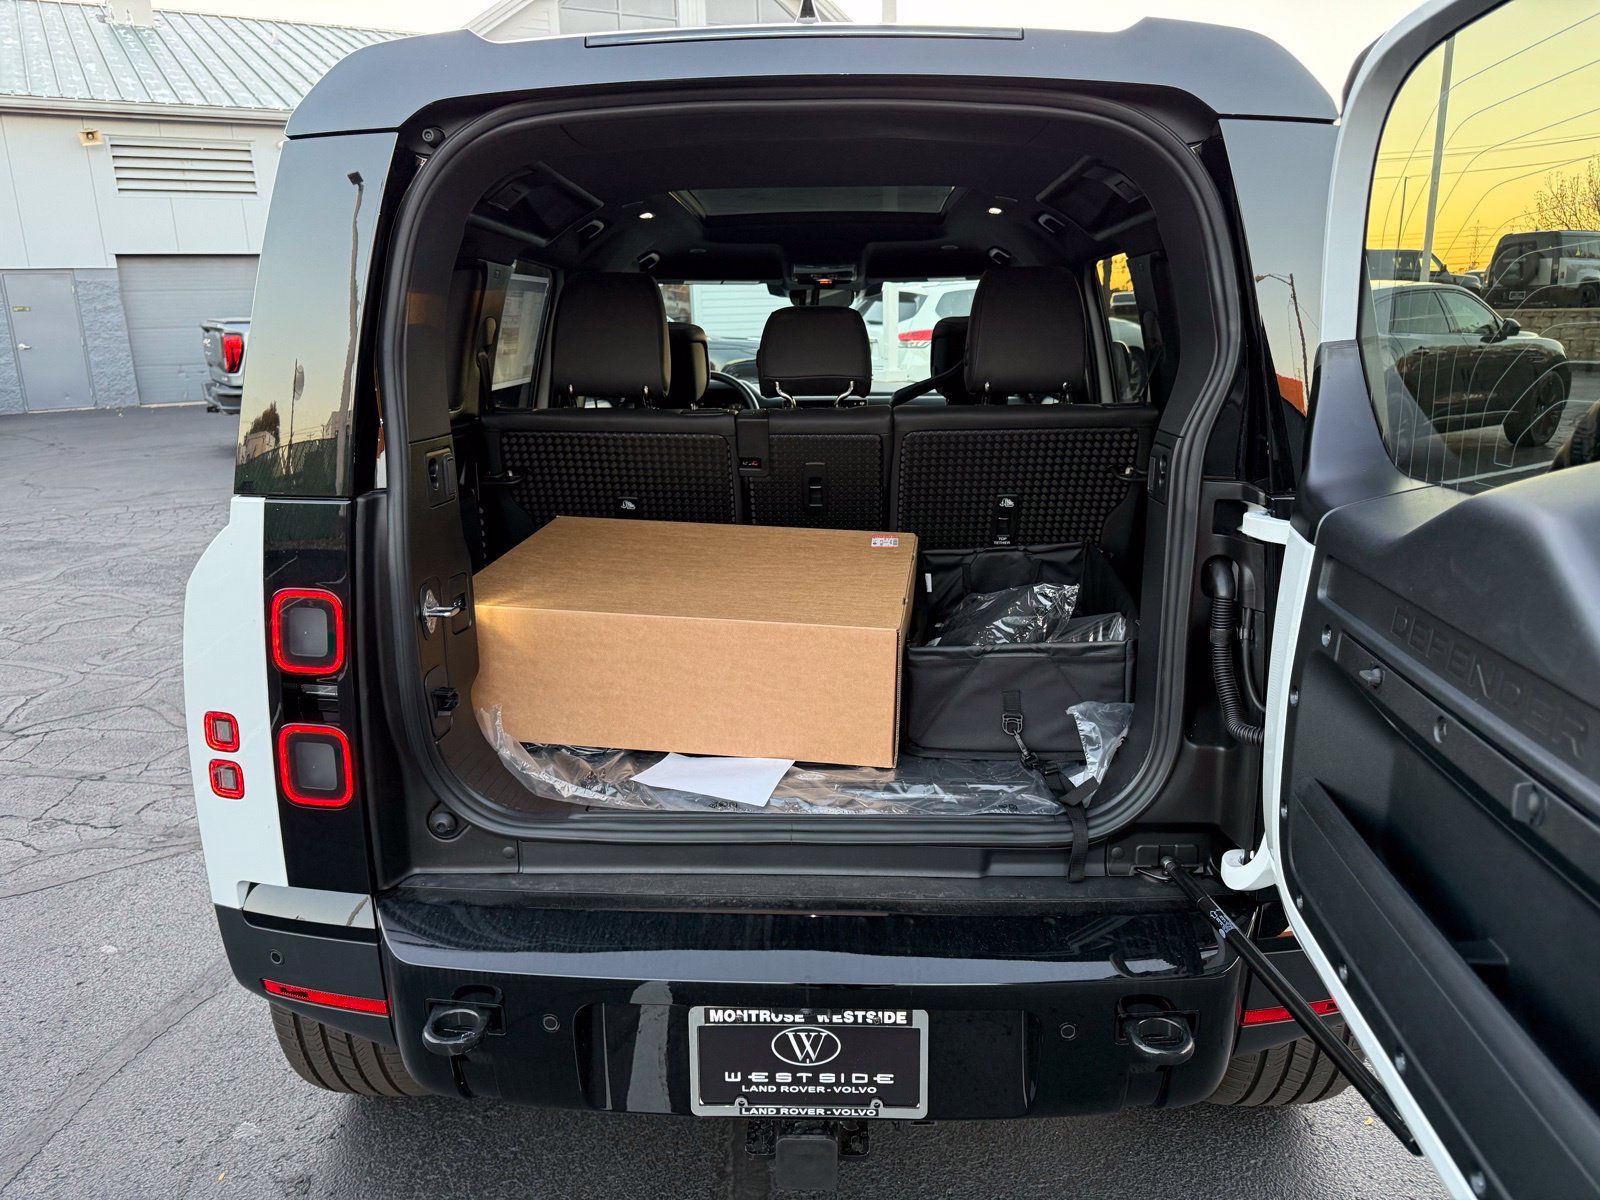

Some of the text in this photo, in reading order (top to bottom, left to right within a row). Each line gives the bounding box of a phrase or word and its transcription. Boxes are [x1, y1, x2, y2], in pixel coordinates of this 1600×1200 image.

[1391, 606, 1590, 760] DEFENDER
[724, 1071, 895, 1084] WESTSIDE
[741, 1085, 777, 1093] LAND
[741, 1108, 777, 1116] LAND
